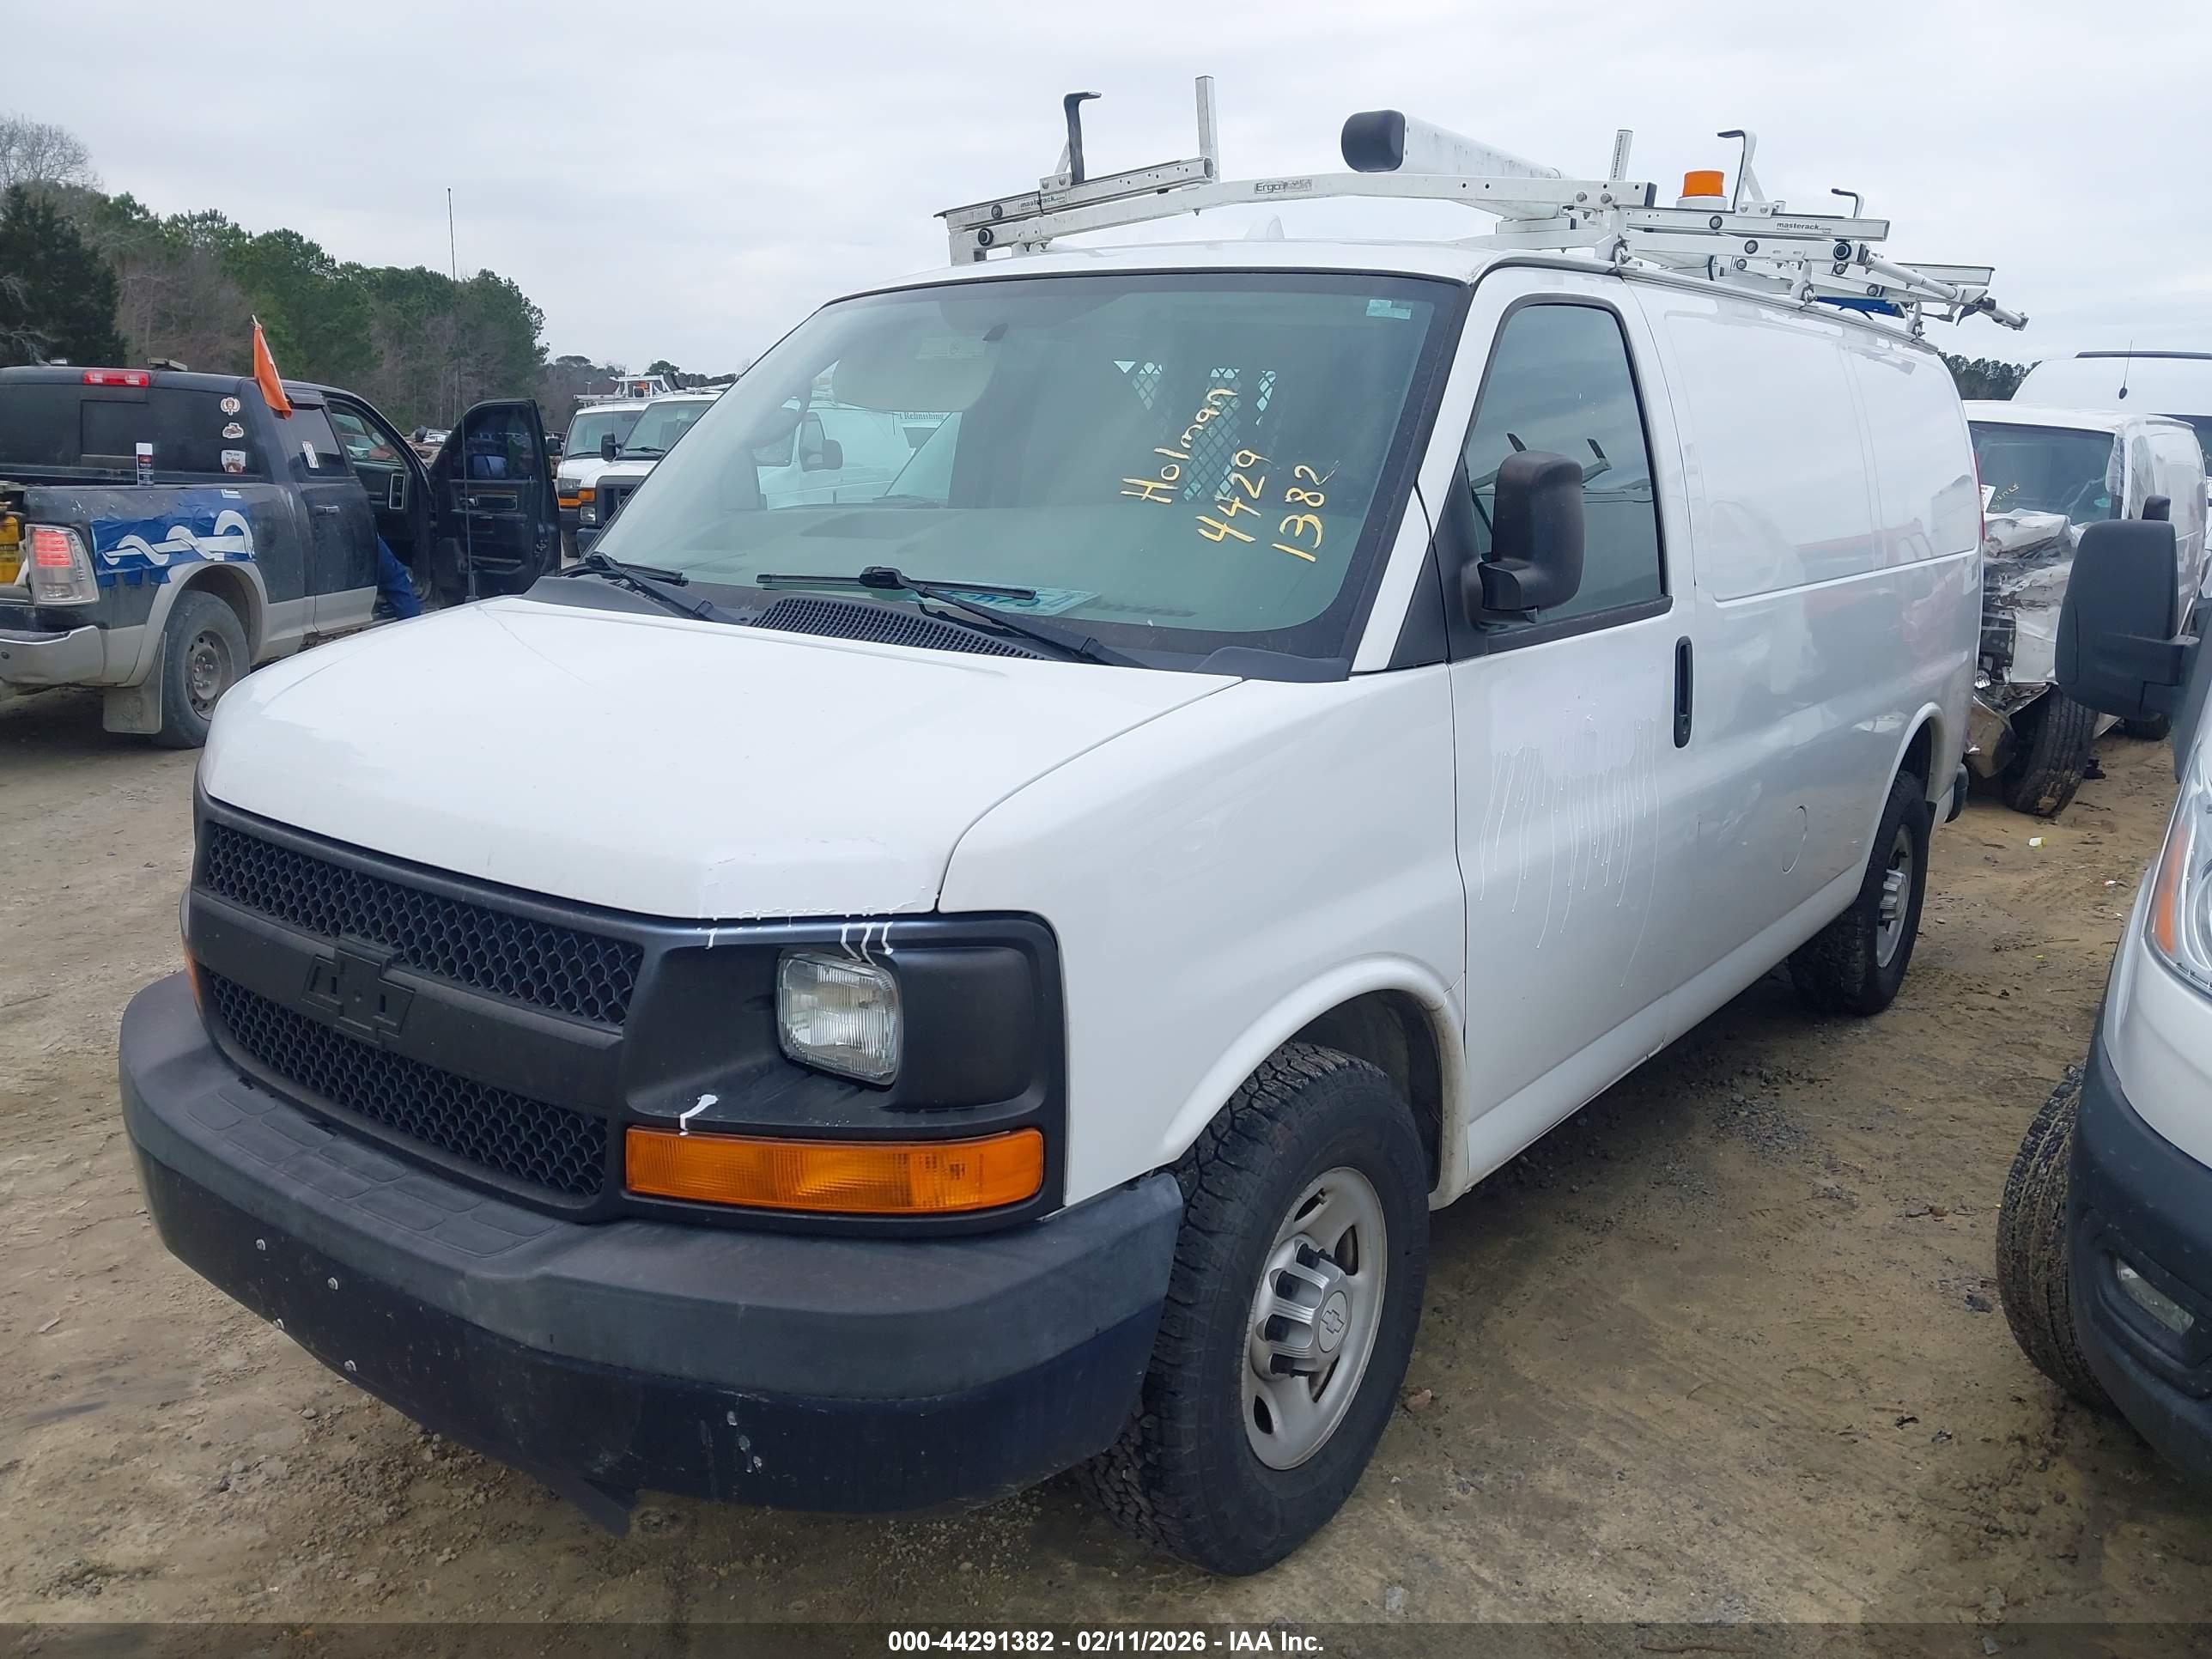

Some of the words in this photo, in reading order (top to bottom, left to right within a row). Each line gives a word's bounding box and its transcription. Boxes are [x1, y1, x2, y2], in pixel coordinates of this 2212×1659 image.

[1120, 388, 1239, 504] Holman
[1196, 449, 1280, 543] 4429
[1271, 460, 1341, 562] 1382
